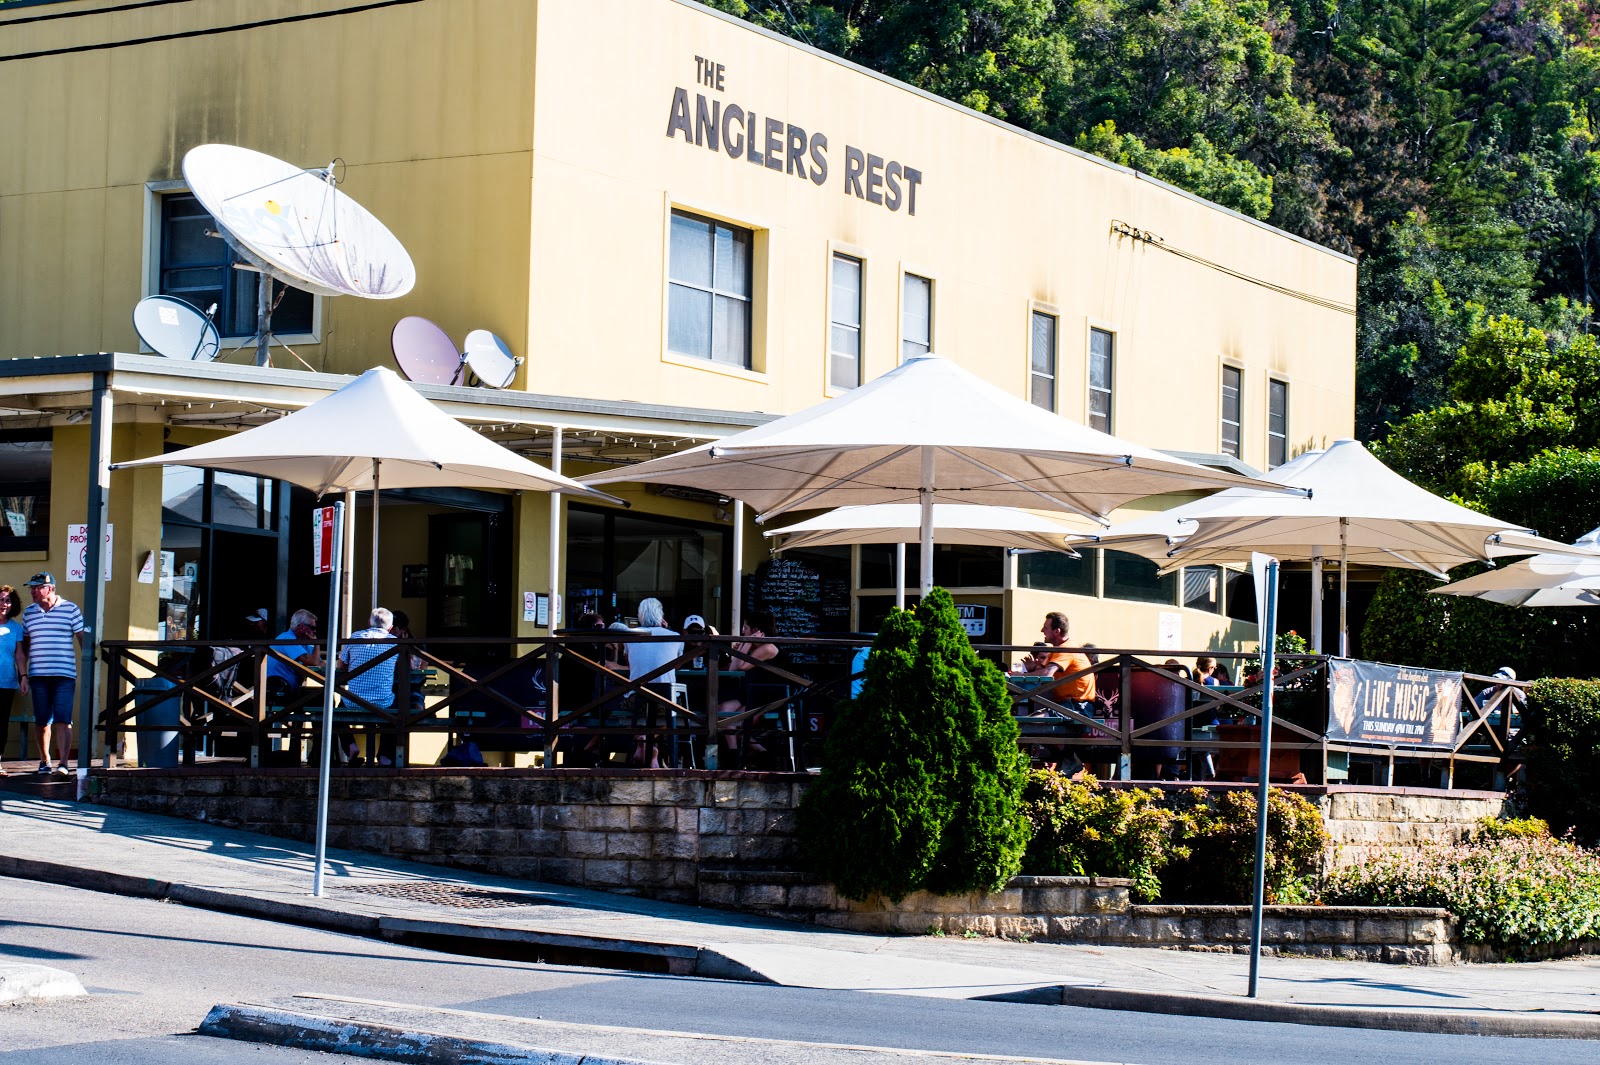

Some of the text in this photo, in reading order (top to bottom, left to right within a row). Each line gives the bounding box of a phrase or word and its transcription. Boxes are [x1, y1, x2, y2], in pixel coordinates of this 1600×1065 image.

[694, 55, 725, 92] THE
[666, 86, 922, 216] ANGLERS REST
[956, 606, 974, 618] TM
[1363, 720, 1374, 731] THIS
[1374, 721, 1395, 733] SUNDAY
